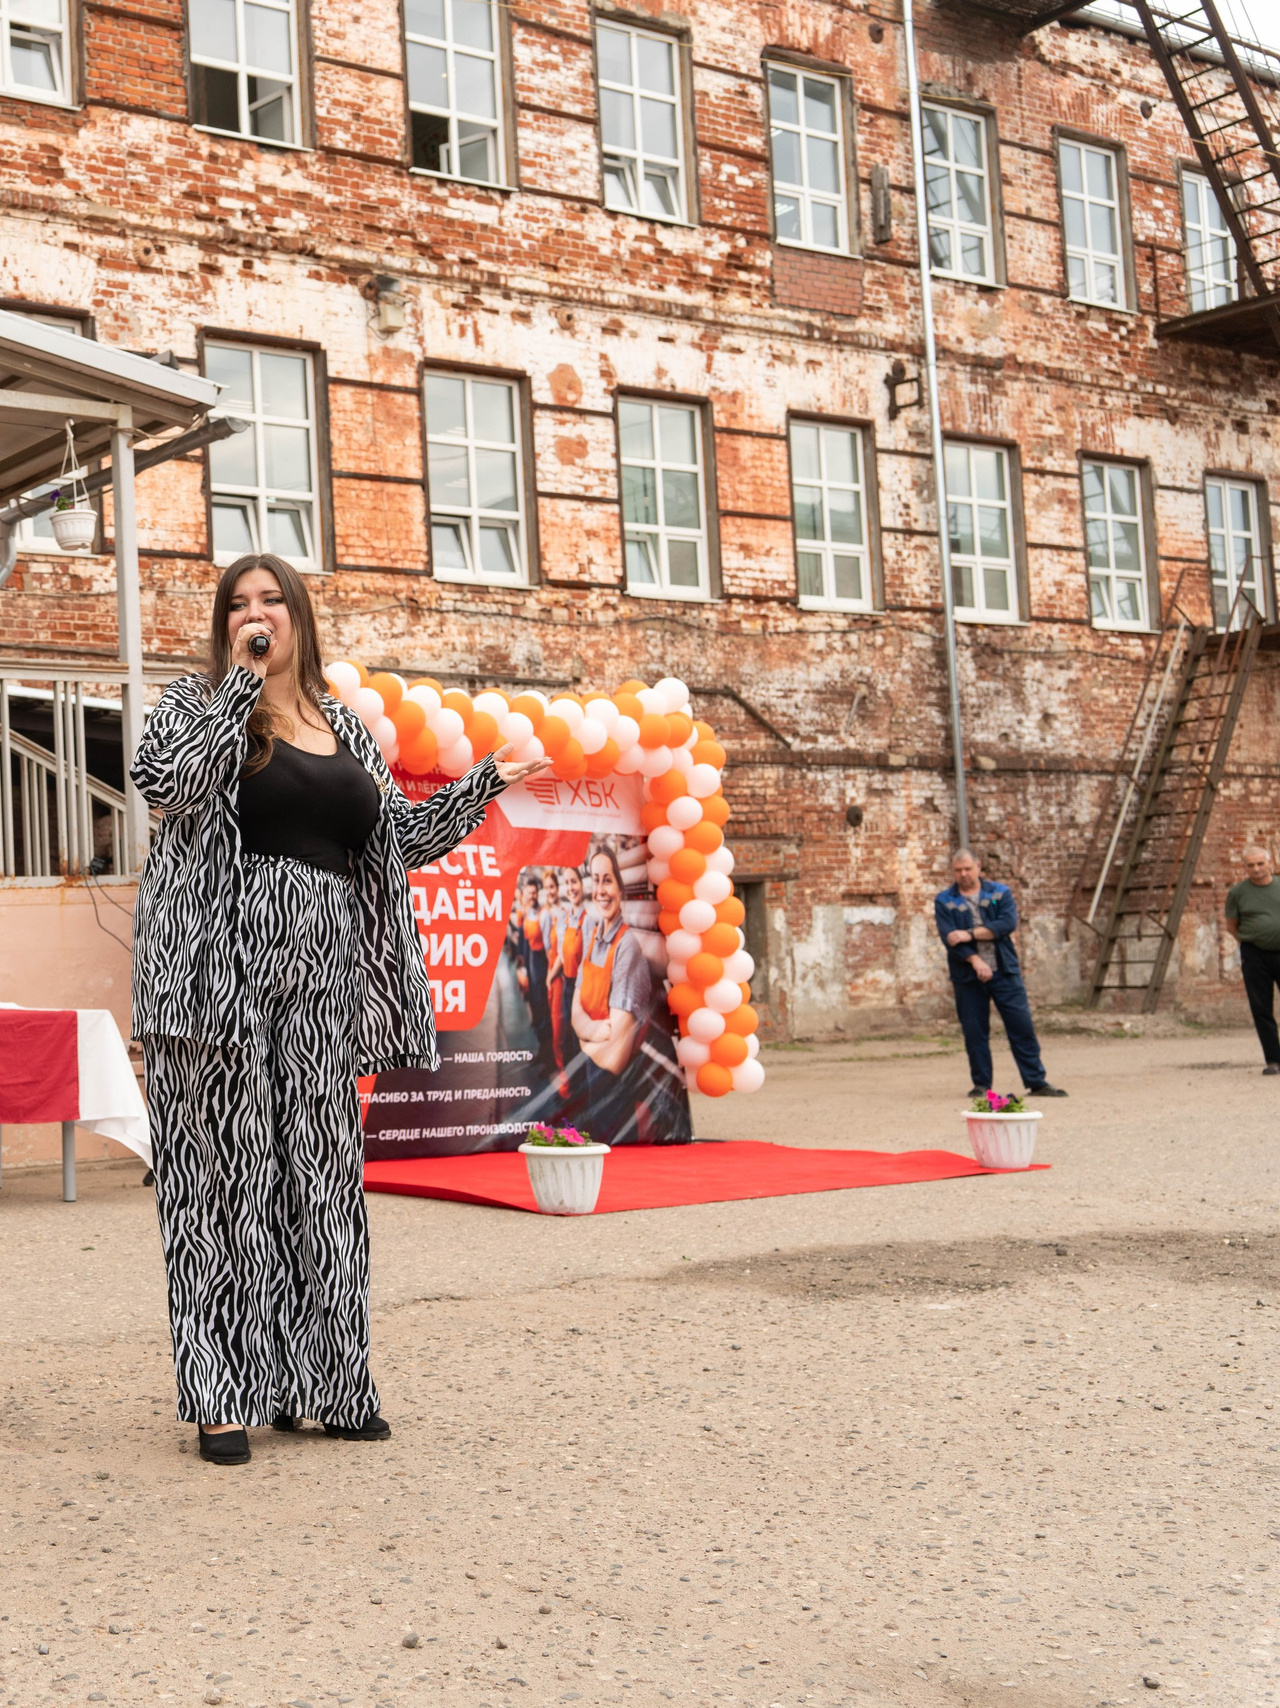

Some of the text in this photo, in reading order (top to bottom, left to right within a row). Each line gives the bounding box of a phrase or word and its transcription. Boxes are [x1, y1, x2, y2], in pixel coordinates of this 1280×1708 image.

[454, 1052, 485, 1063] НАША
[486, 1050, 533, 1063] ГОРДОСТЬ
[359, 1086, 532, 1104] СПАСИБО ЗА ТРУД И ПРЕДАННОСТЬ
[378, 1128, 421, 1141] СЕРДЦЕ
[422, 1125, 465, 1138] НАШЕГО
